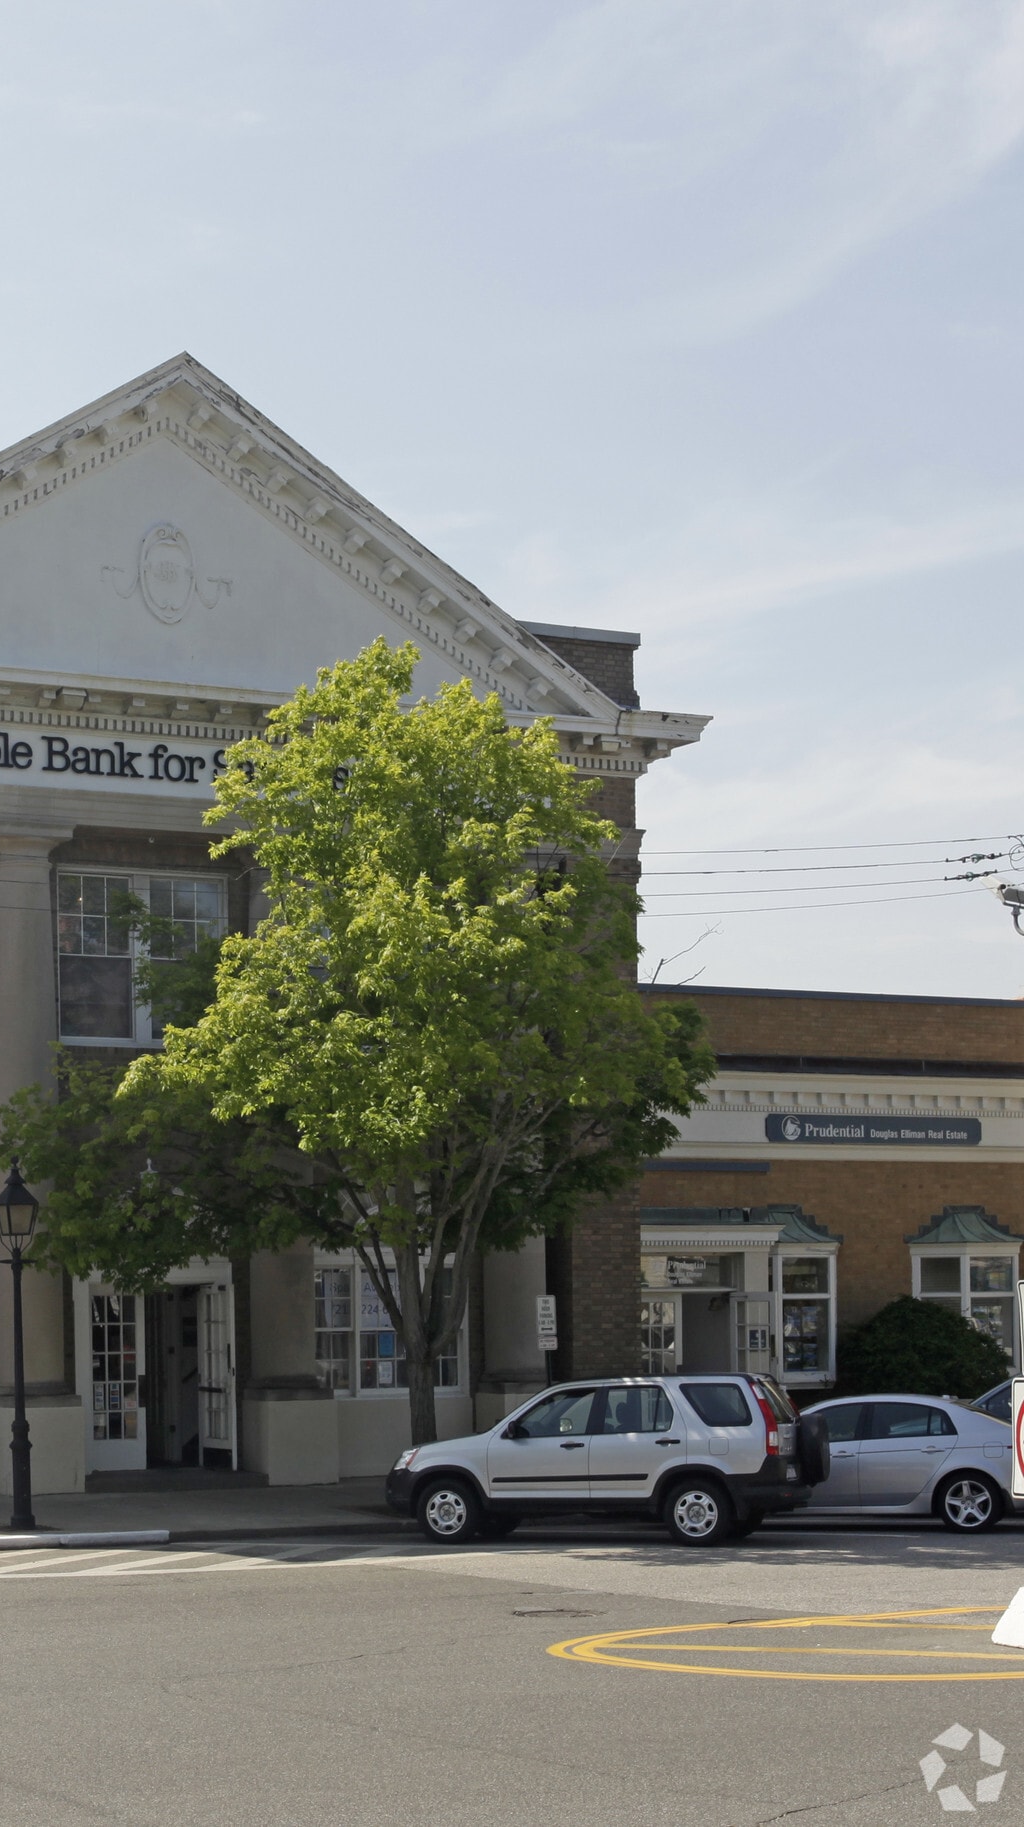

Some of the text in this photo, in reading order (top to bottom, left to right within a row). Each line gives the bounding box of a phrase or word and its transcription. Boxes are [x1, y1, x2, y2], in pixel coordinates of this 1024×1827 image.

[41, 735, 144, 779] Bank
[149, 744, 205, 783] for
[805, 1123, 968, 1140] Prudential Douglas Elliman Real Estate
